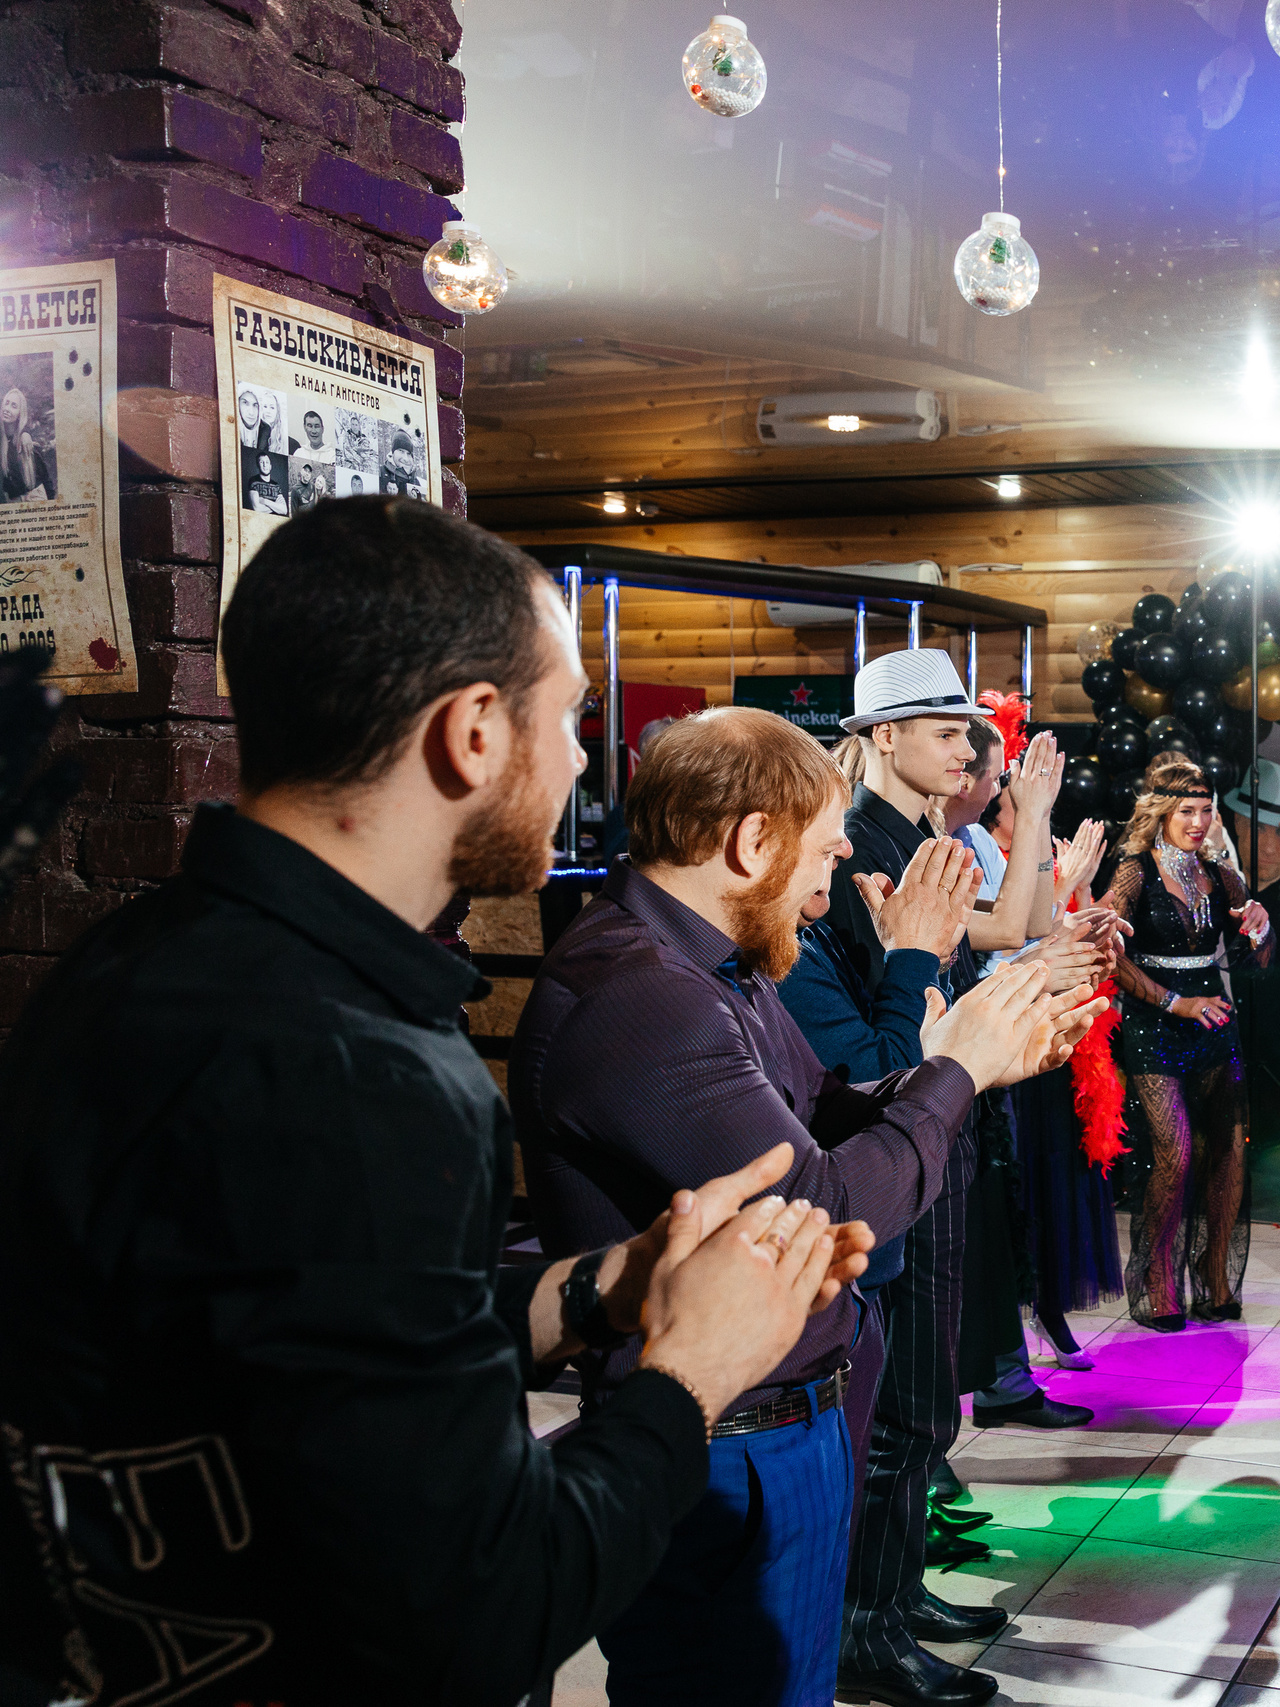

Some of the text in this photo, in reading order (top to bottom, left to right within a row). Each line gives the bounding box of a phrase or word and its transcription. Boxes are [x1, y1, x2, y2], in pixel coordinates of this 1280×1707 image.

[234, 306, 422, 397] РАЗЫСКИВАЕТСЯ
[294, 373, 380, 410] БАНДА ГАНГСТЕРОВ
[771, 709, 840, 726] ineken
